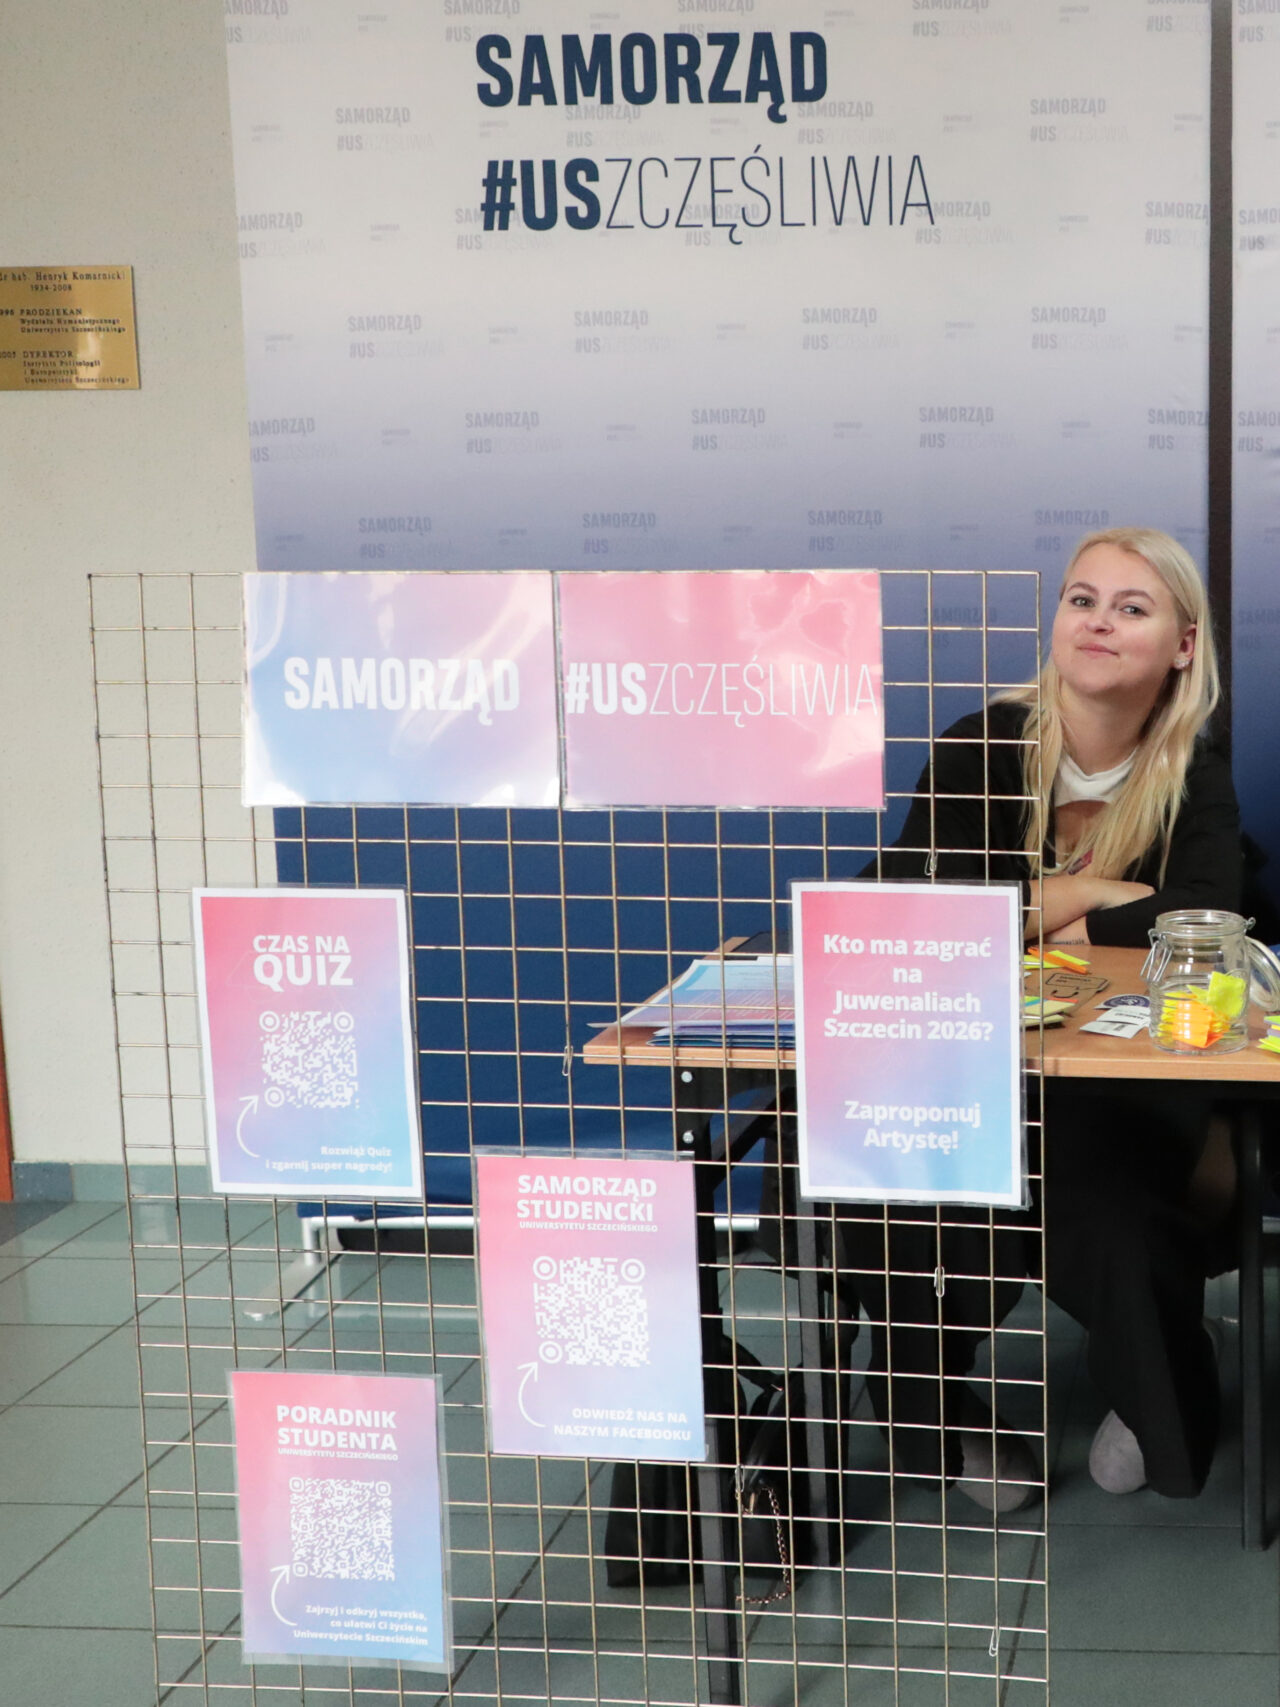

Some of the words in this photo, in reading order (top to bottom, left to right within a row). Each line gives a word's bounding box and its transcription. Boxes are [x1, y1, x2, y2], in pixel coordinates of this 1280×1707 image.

[475, 31, 828, 124] SAMORZĄD
[335, 107, 411, 127] SAMORZĄD
[797, 101, 874, 121] SAMORZĄD
[1030, 98, 1107, 118] SAMORZĄD
[480, 144, 935, 245] #USZCZĘŚLIWIA
[238, 211, 303, 232] AMORZĄD
[348, 314, 422, 335] SAMORZĄD
[574, 310, 649, 330] SAMORZĄD
[802, 307, 877, 328] SAMORZĄD
[1031, 307, 1106, 327] SAMORZĄD
[465, 411, 540, 431] SAMORZĄD
[691, 408, 766, 427] SAMORZĄD
[919, 406, 994, 427] SAMORZĄD
[358, 517, 432, 536] SAMORZĄD
[583, 512, 657, 532] SAMORZĄD
[808, 509, 883, 530] SAMORZĄD
[284, 656, 520, 726] SAMORZĄD
[565, 655, 878, 729] #USZCZĘŚLIWIA
[253, 934, 309, 953] CZAS
[315, 935, 350, 954] NA
[823, 934, 864, 954] Kto
[870, 939, 908, 955] ma
[913, 937, 992, 962] zagrać
[253, 954, 354, 992] QUIZ
[893, 967, 923, 983] na
[833, 990, 981, 1014] Juwenaliach
[824, 1018, 922, 1039] Szczecin
[927, 1020, 994, 1042] 2026?
[844, 1100, 981, 1129] Zaproponuj
[863, 1128, 959, 1155] Artystę!
[368, 1147, 392, 1158] Quiz
[271, 1159, 309, 1173] zgarnij
[311, 1162, 343, 1173] super
[345, 1161, 393, 1174] nagrody!
[518, 1175, 657, 1202] SAMORZĄD
[517, 1199, 654, 1222] STUDENCKI
[519, 1221, 585, 1231] UNIWERSYTETU
[587, 1222, 658, 1232] SZCZECIŃSKIEGO
[277, 1405, 396, 1429] PORADNIK
[572, 1406, 634, 1421] ODWIEDŹ
[637, 1410, 664, 1422] NAS
[668, 1412, 687, 1423] NA
[278, 1428, 397, 1451] STUDENTA
[554, 1425, 609, 1437] NASZYM
[612, 1427, 691, 1441] FACEBOOKU
[278, 1448, 335, 1459] UNIWERSYTETU
[336, 1450, 398, 1461] SZCZECIŃSKIEGO
[306, 1605, 338, 1617] Zajrzyj
[346, 1606, 378, 1618] odkryj
[330, 1620, 342, 1628] co
[343, 1619, 376, 1630] ułatwi
[378, 1620, 388, 1630] Ci
[390, 1621, 414, 1634] życie
[416, 1623, 428, 1632] na
[293, 1629, 363, 1643] Uniwersytecie
[365, 1633, 428, 1646] Szczecińskim
